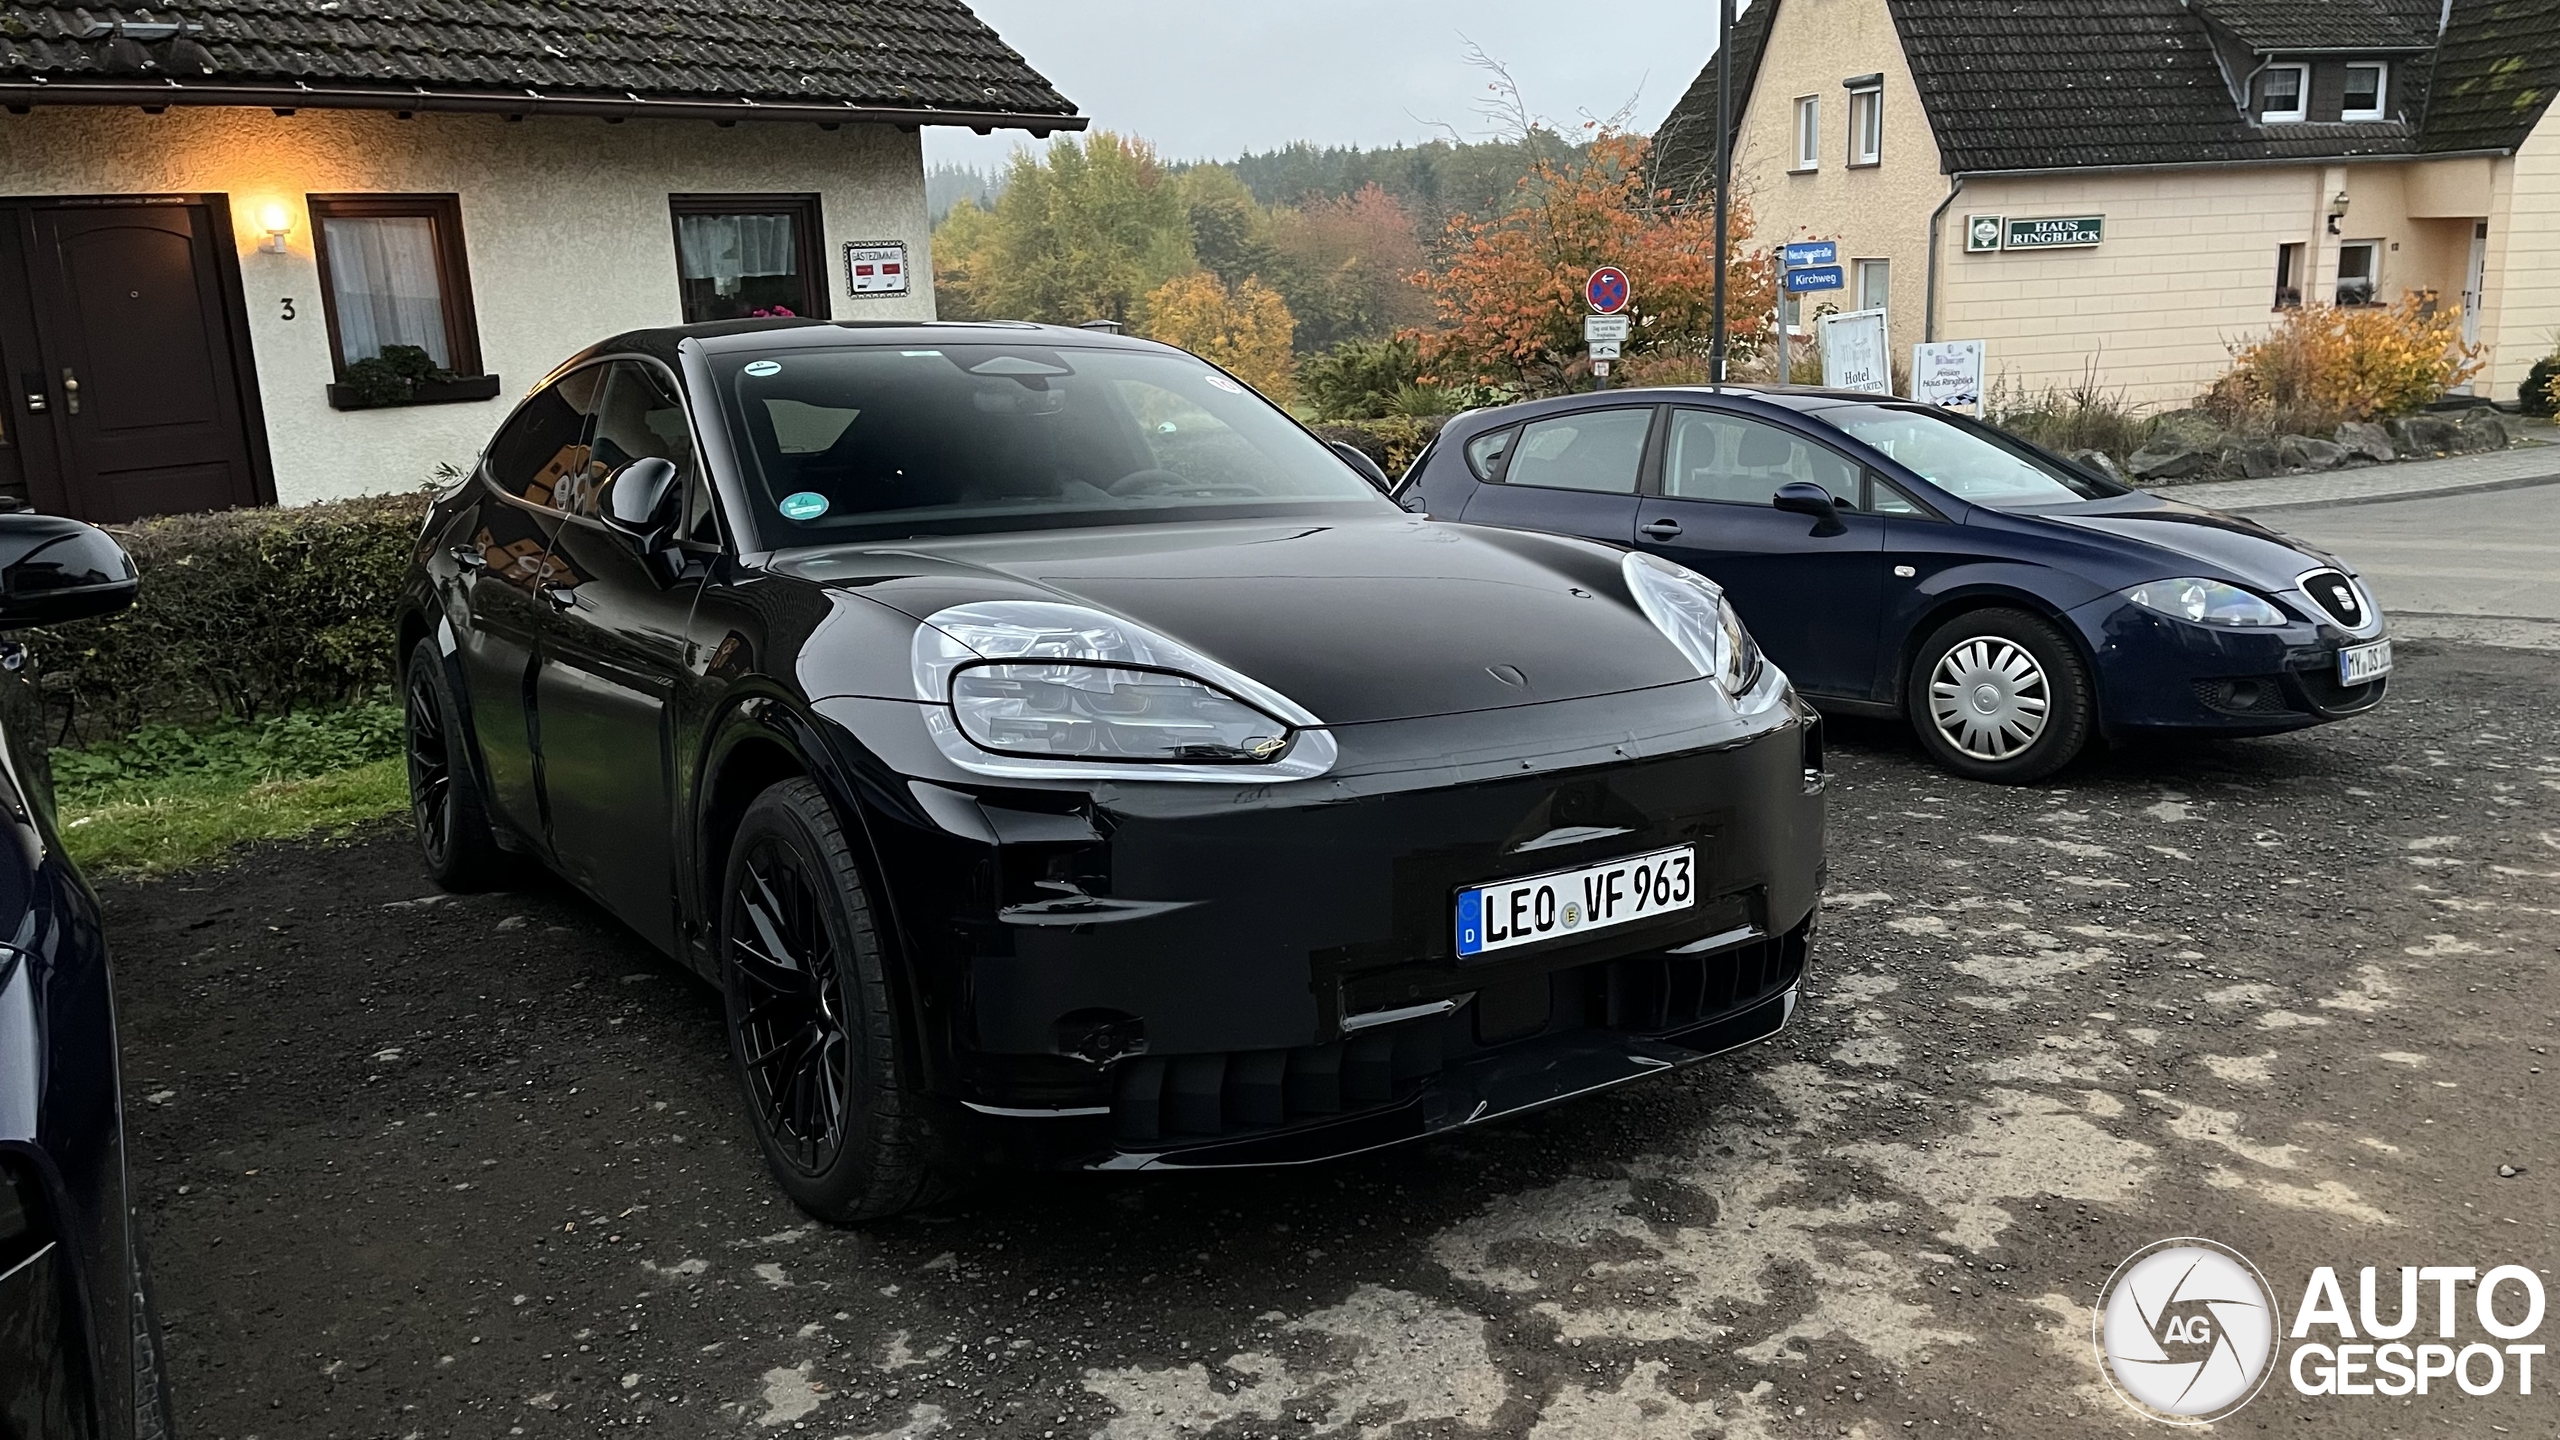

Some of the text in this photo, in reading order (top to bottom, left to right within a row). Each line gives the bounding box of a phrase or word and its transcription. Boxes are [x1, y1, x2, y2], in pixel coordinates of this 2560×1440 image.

[2035, 221, 2079, 232] HAUS
[2012, 230, 2099, 244] RINGBLICK
[1795, 274, 1837, 285] Kirchweg
[280, 297, 296, 321] 3
[1844, 366, 1870, 385] Hotel
[1942, 376, 1975, 387] Ringblick
[1486, 856, 1691, 943] LEO VF 963
[1465, 929, 1475, 943] D
